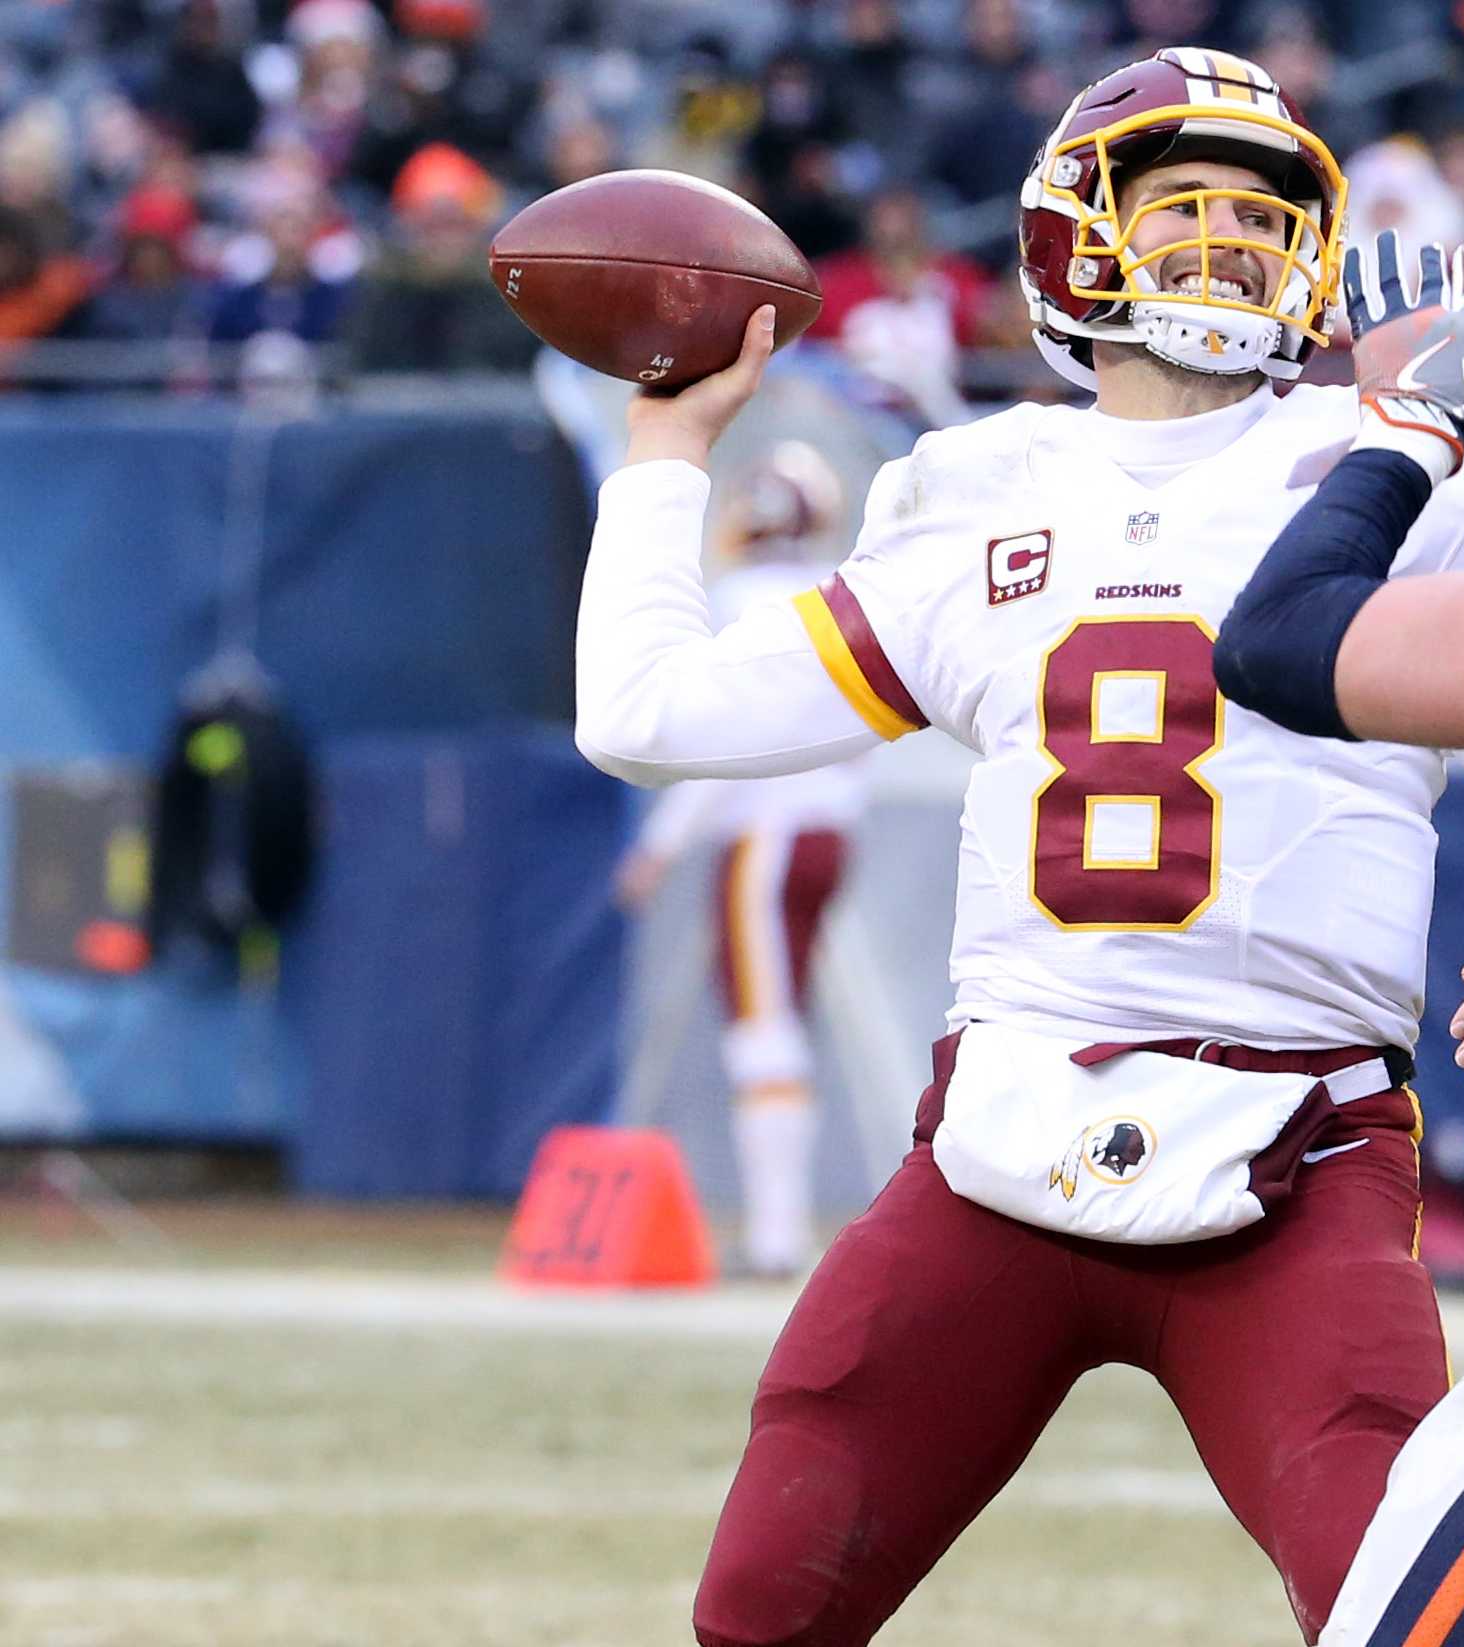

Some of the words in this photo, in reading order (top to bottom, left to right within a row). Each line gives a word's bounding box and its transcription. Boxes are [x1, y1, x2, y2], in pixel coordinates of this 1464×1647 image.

[1128, 525, 1154, 542] NFL
[990, 532, 1048, 589] C
[1095, 583, 1182, 600] REDSKINS
[1028, 614, 1226, 933] 8
